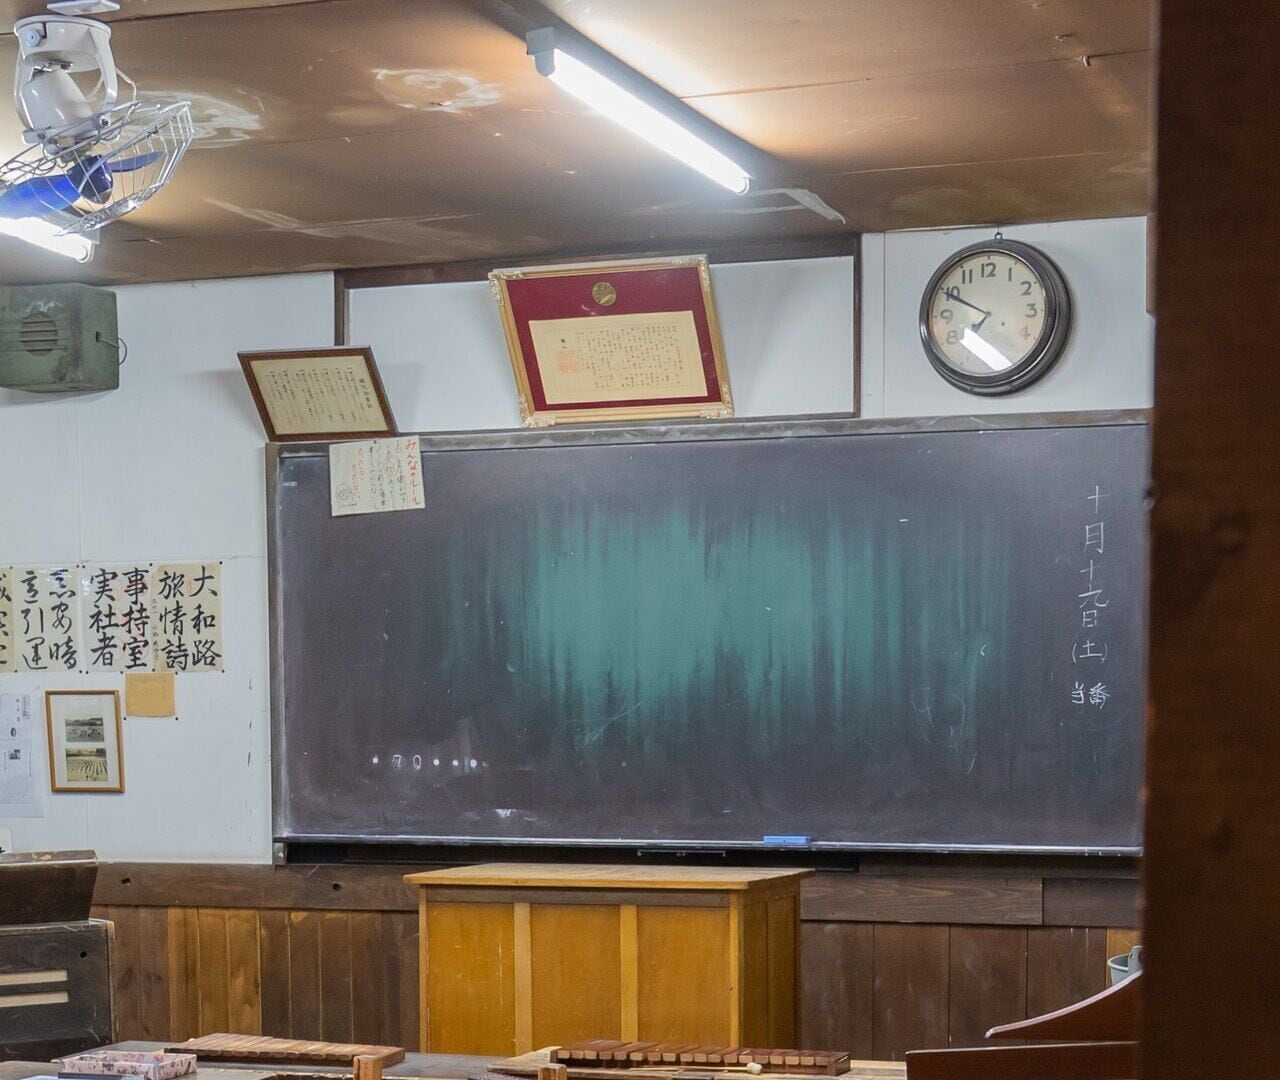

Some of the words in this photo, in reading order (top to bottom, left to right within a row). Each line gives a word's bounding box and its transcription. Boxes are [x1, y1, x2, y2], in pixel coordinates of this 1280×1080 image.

[962, 269, 973, 284] 11
[981, 262, 996, 278] 12
[1008, 267, 1012, 282] 1
[944, 286, 960, 301] 10
[1020, 281, 1032, 296] 2
[940, 309, 953, 324] 9
[1025, 303, 1037, 318] 3
[946, 330, 959, 345] 8
[1020, 325, 1031, 340] 4
[89, 568, 120, 666] 実社者
[121, 567, 150, 669] 事持室
[158, 570, 189, 671] 旅情詩
[189, 565, 222, 667] 大和路
[1071, 681, 1110, 709] 当番
